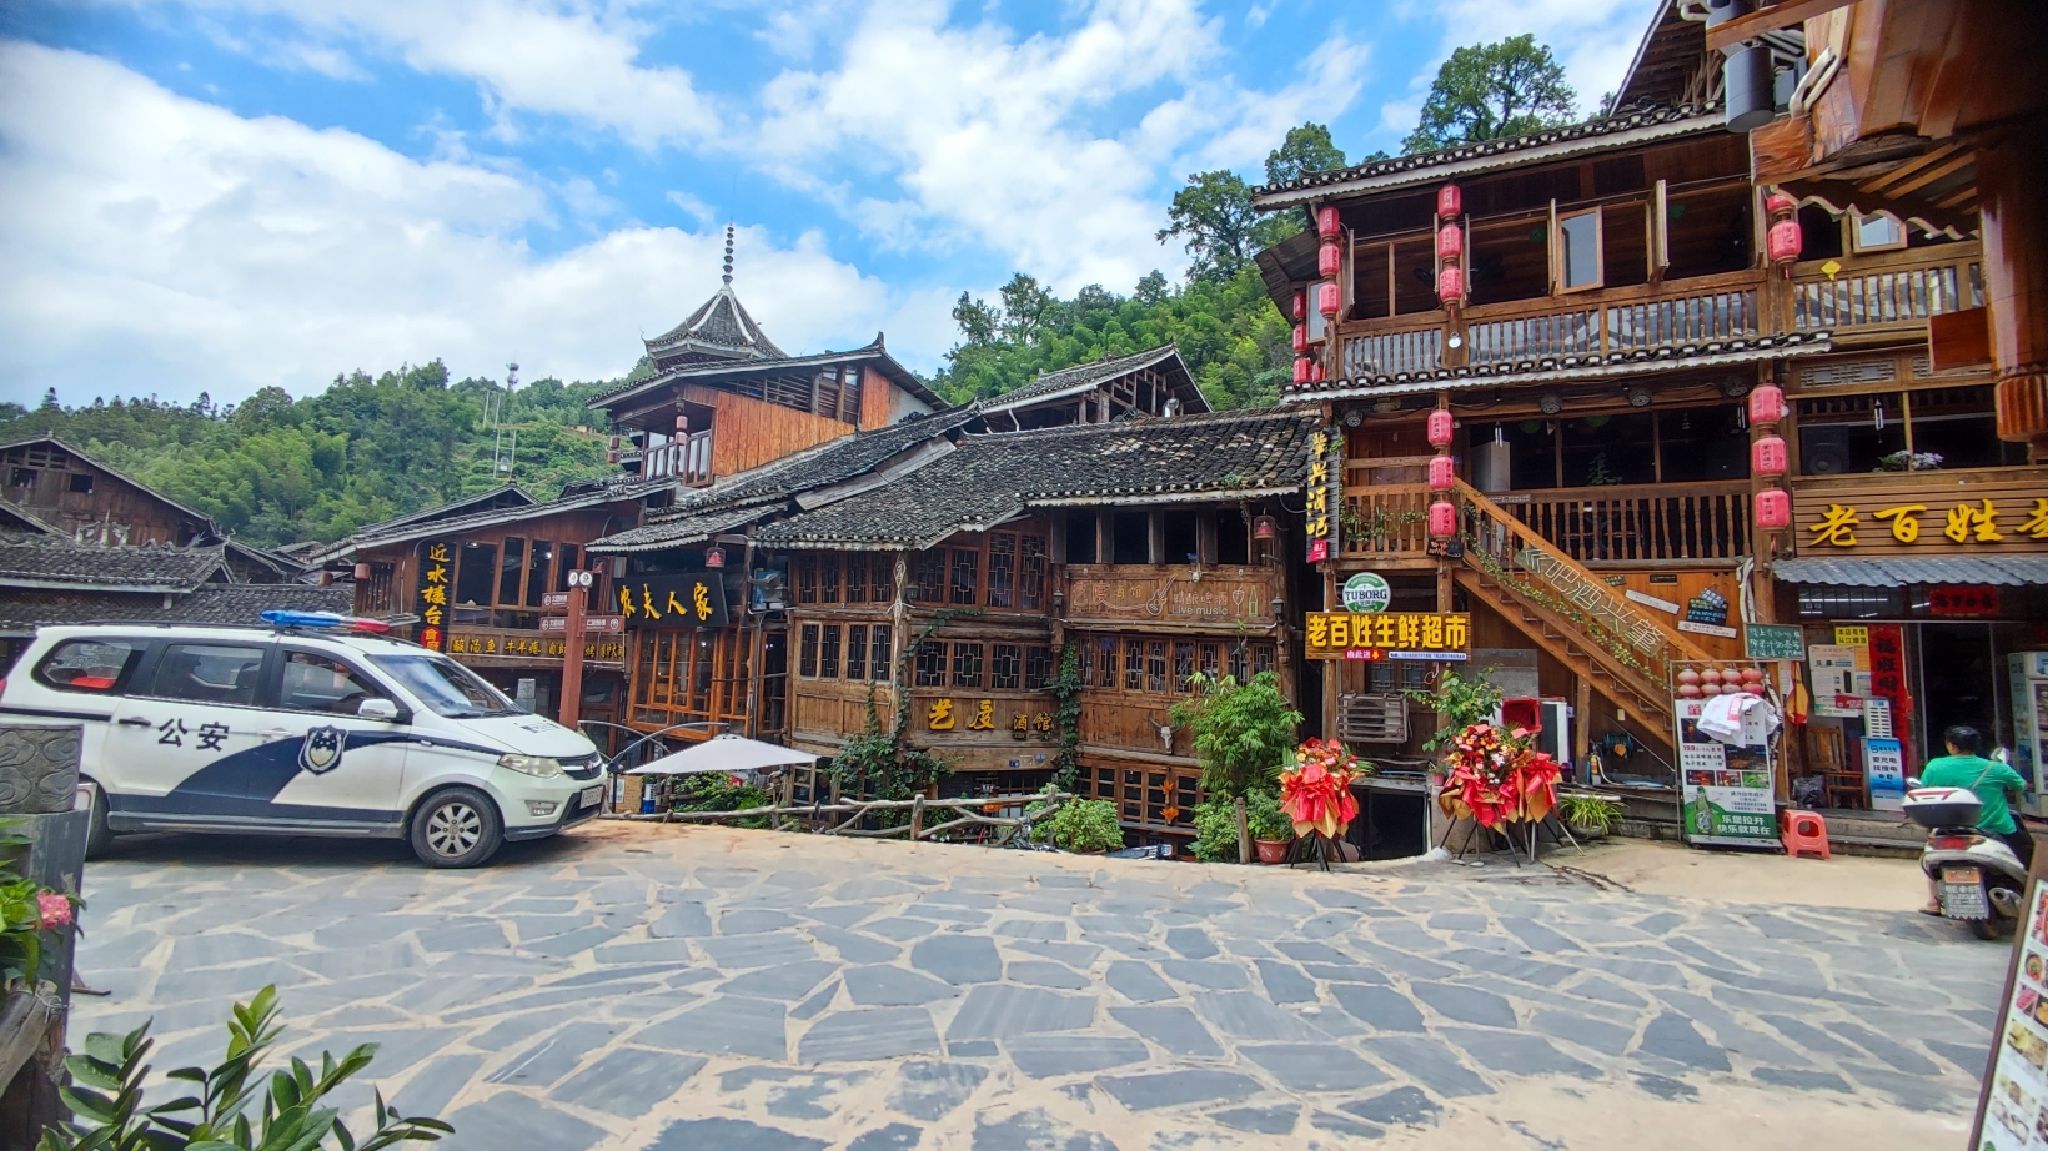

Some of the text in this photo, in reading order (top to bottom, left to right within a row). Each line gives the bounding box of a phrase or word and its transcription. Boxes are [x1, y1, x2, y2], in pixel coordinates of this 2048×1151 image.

[421, 542, 450, 625] 近水楼台
[1345, 589, 1387, 601] TUBORG
[1173, 606, 1228, 615] Live music
[1308, 614, 1466, 649] 老百姓生鲜超市
[158, 717, 230, 752] 公安
